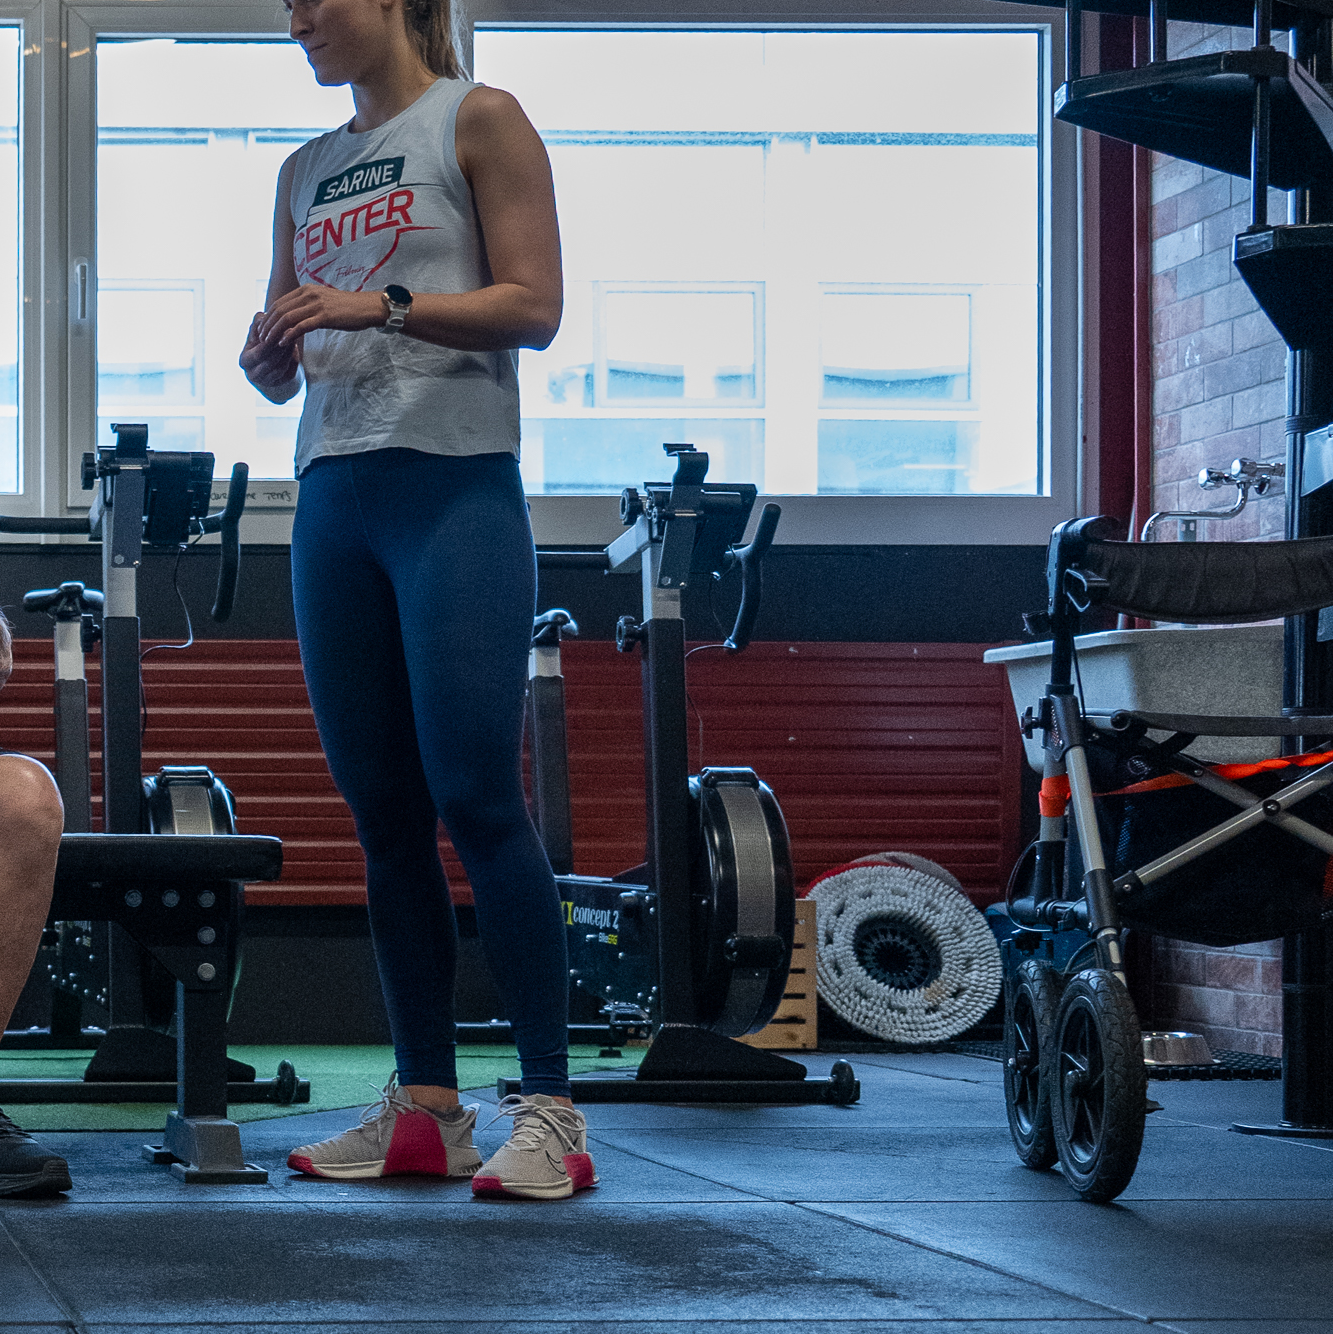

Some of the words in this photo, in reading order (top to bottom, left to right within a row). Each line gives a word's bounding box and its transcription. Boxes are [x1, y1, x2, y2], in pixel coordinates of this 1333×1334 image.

[322, 164, 395, 201] SARINE
[293, 188, 415, 271] CENTER
[573, 906, 611, 929] concept
[612, 910, 619, 930] 2
